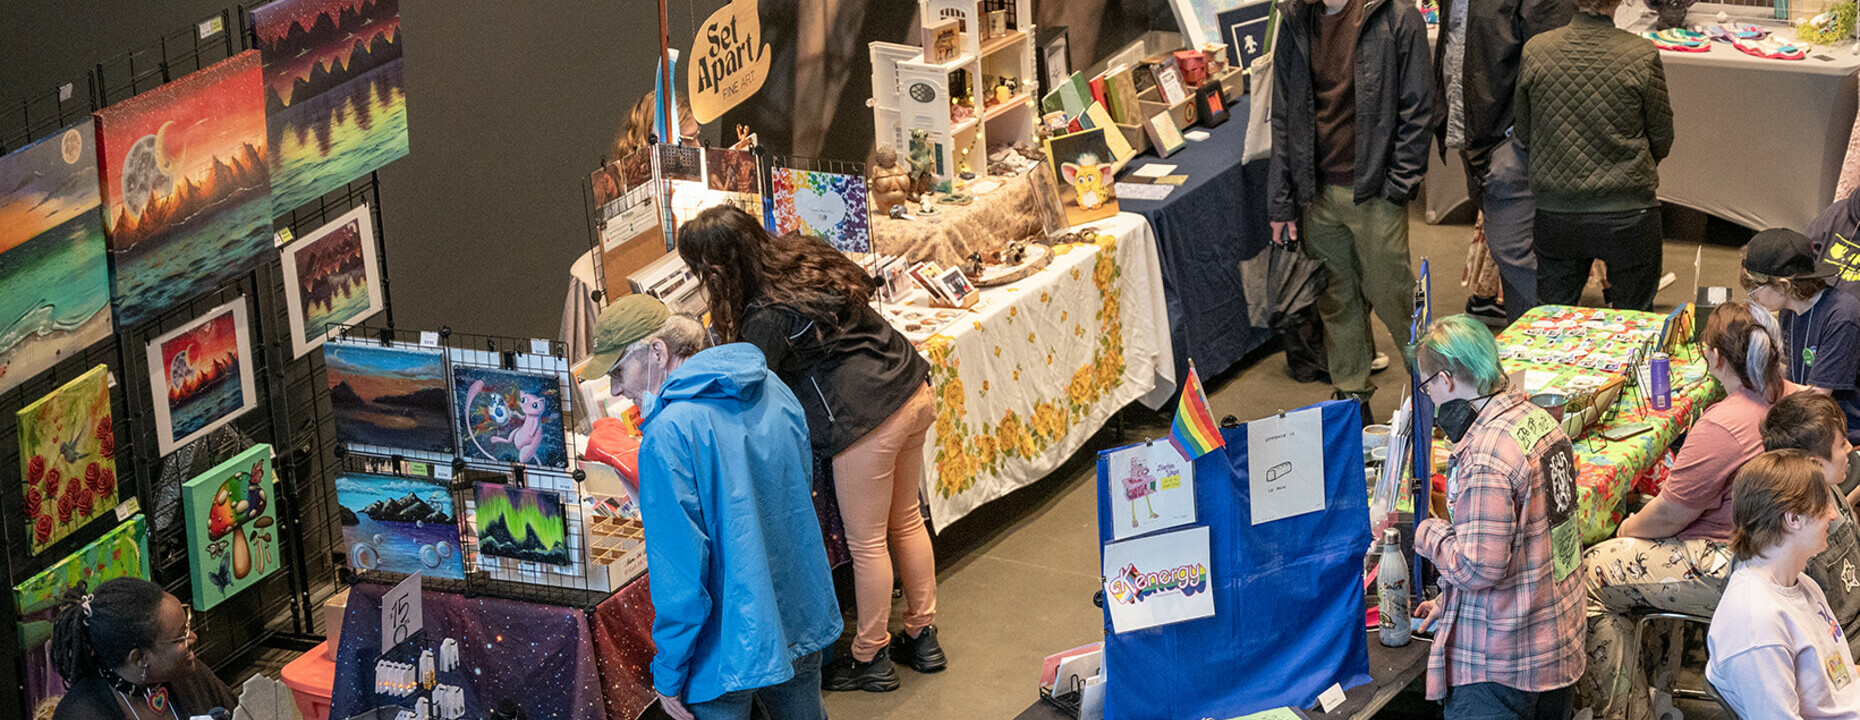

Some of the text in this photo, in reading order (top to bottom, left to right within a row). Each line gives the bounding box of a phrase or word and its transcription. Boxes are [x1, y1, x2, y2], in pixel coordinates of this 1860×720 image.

[707, 14, 738, 57] Set
[697, 32, 753, 94] Apart
[722, 70, 755, 99] FINE ART
[1109, 563, 1206, 605] Kenergy
